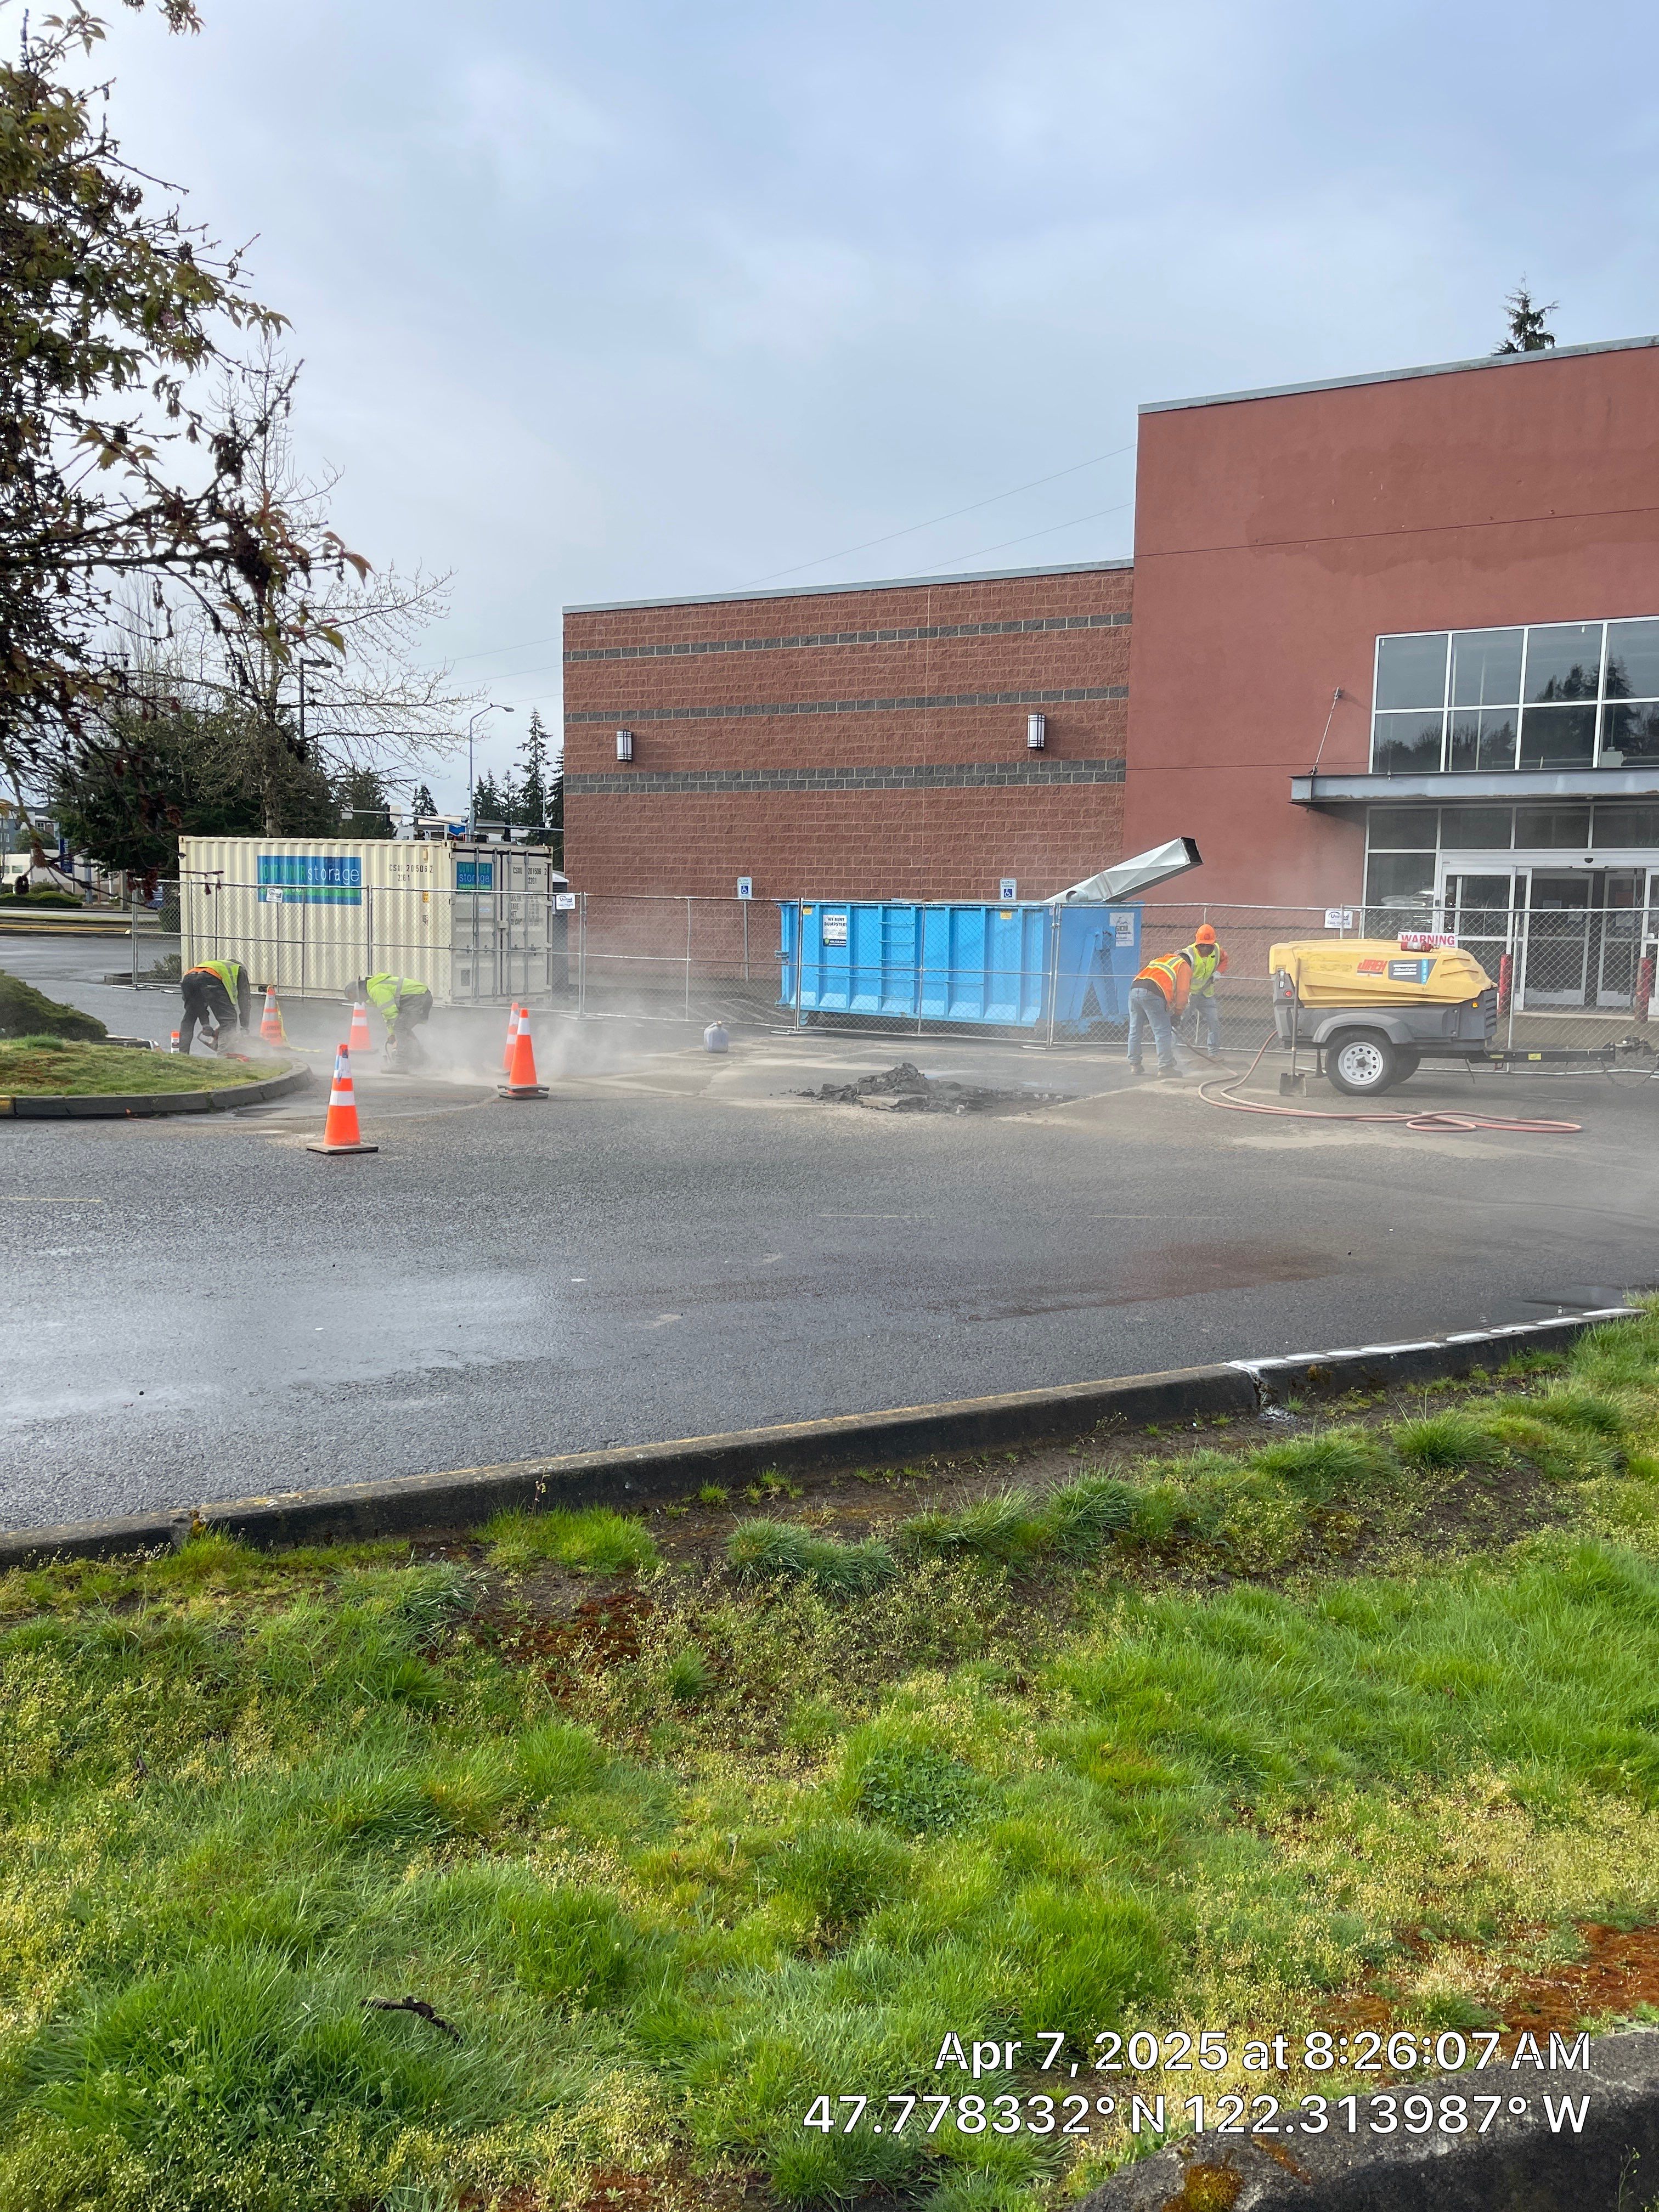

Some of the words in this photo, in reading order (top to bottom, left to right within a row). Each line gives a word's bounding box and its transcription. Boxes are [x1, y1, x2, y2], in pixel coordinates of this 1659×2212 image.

[407, 865, 427, 873] 20506
[459, 864, 490, 874] CONTNER
[307, 865, 359, 885] storage
[459, 872, 490, 884] storge
[1401, 934, 1455, 945] WARNING
